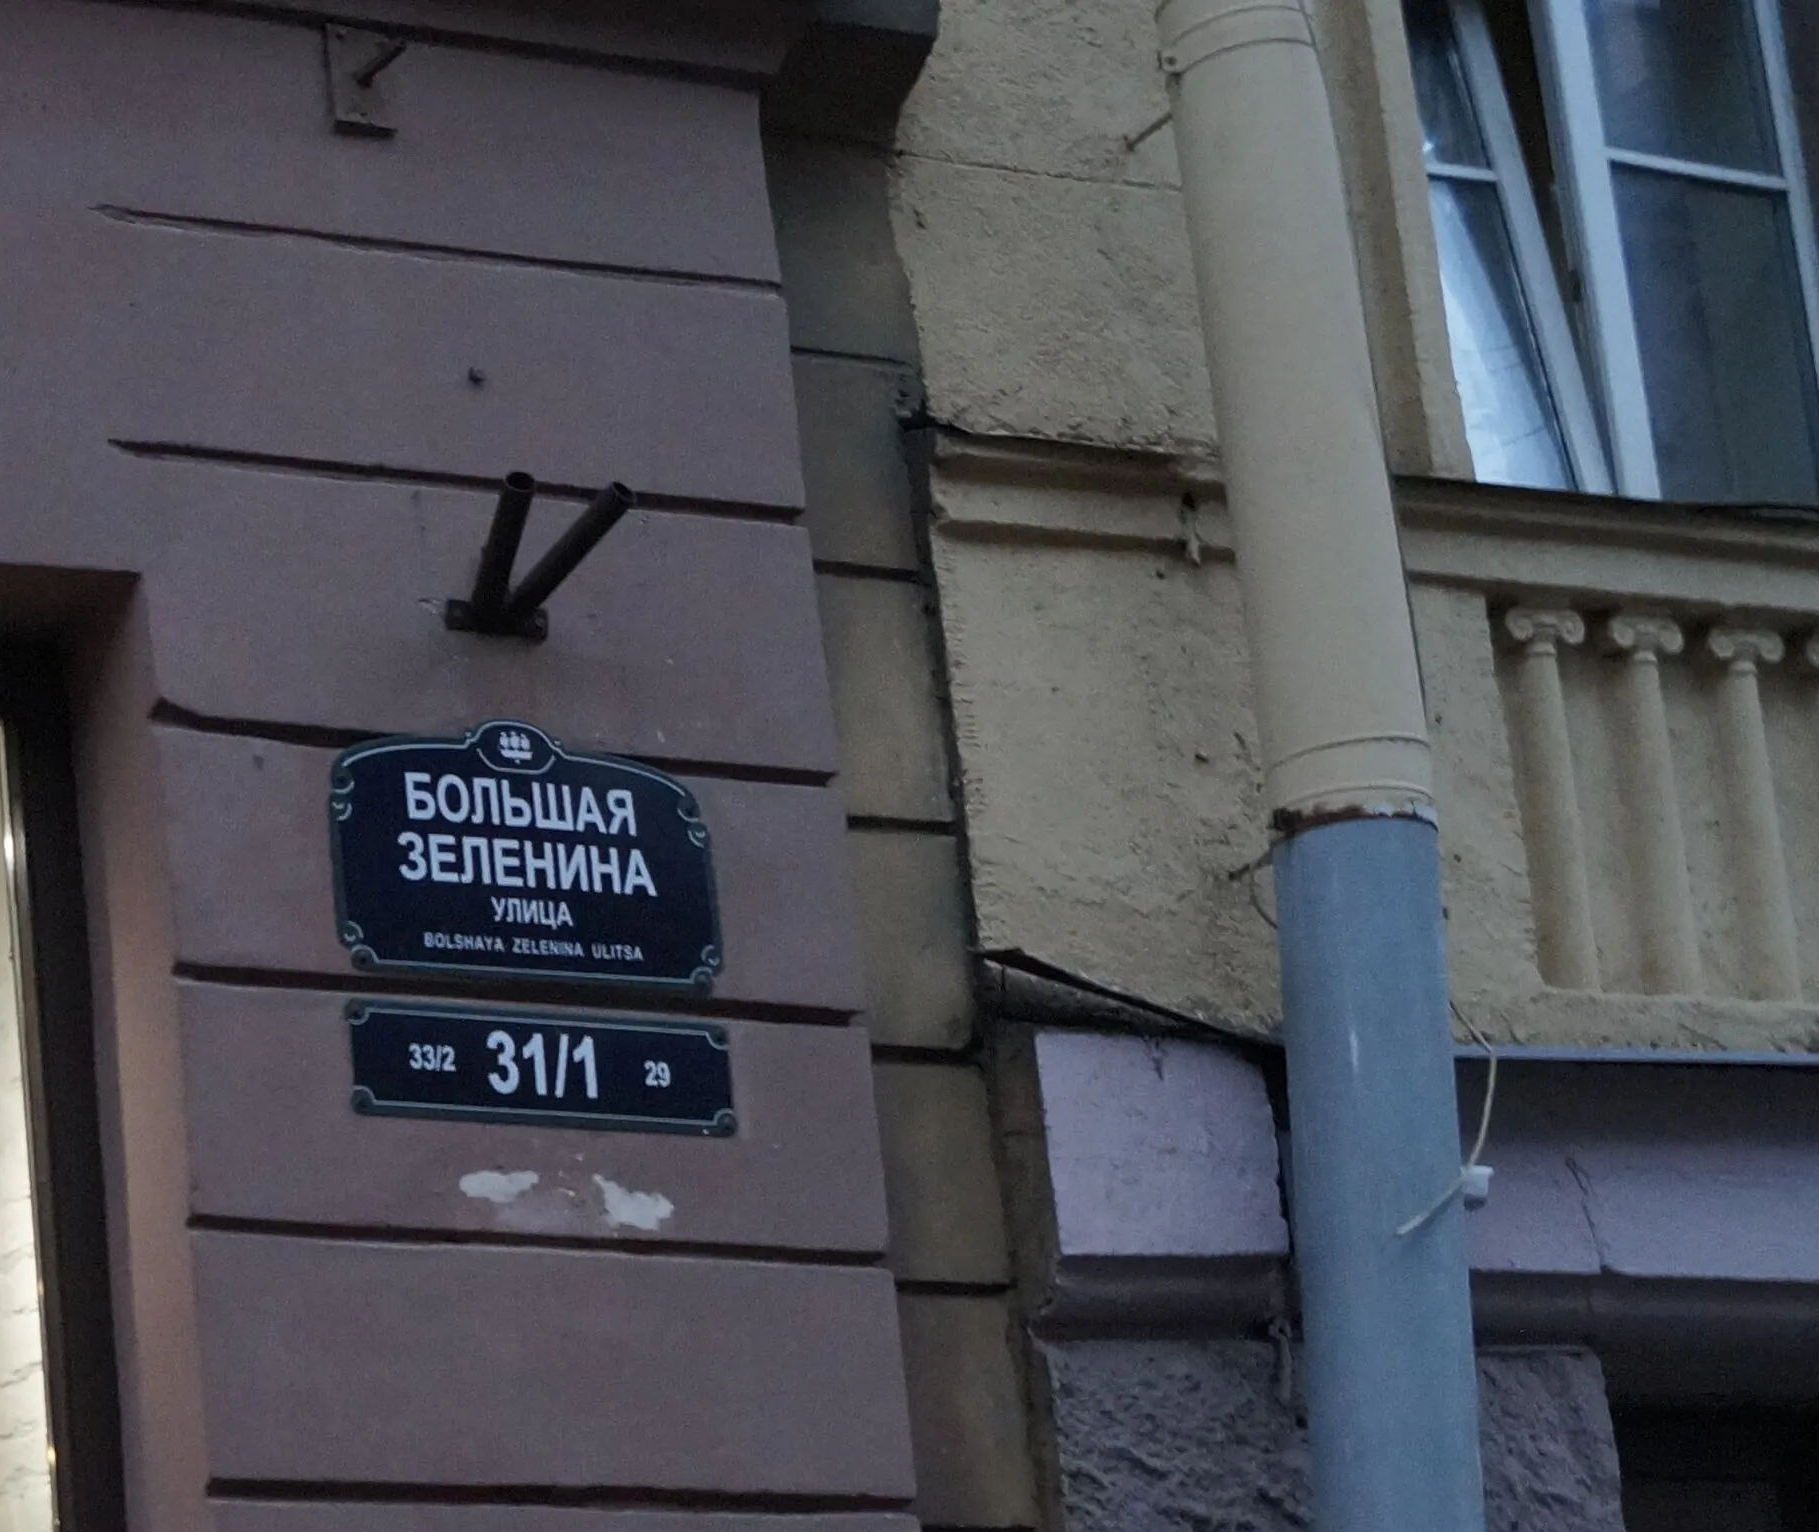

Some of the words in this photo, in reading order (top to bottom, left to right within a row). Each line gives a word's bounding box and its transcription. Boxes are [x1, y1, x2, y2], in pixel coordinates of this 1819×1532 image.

[404, 771, 637, 837] БОЛЬШАЯ
[397, 831, 658, 897] ЗЕЛЕНИНА
[423, 931, 505, 953] BOLSHAYA
[511, 937, 585, 958] ZELENINA
[591, 943, 644, 961] ULITSA
[490, 896, 574, 930] УЛИЦА
[408, 1042, 457, 1073] 33/2
[485, 1029, 599, 1100] 31/1
[644, 1059, 672, 1088] 29
